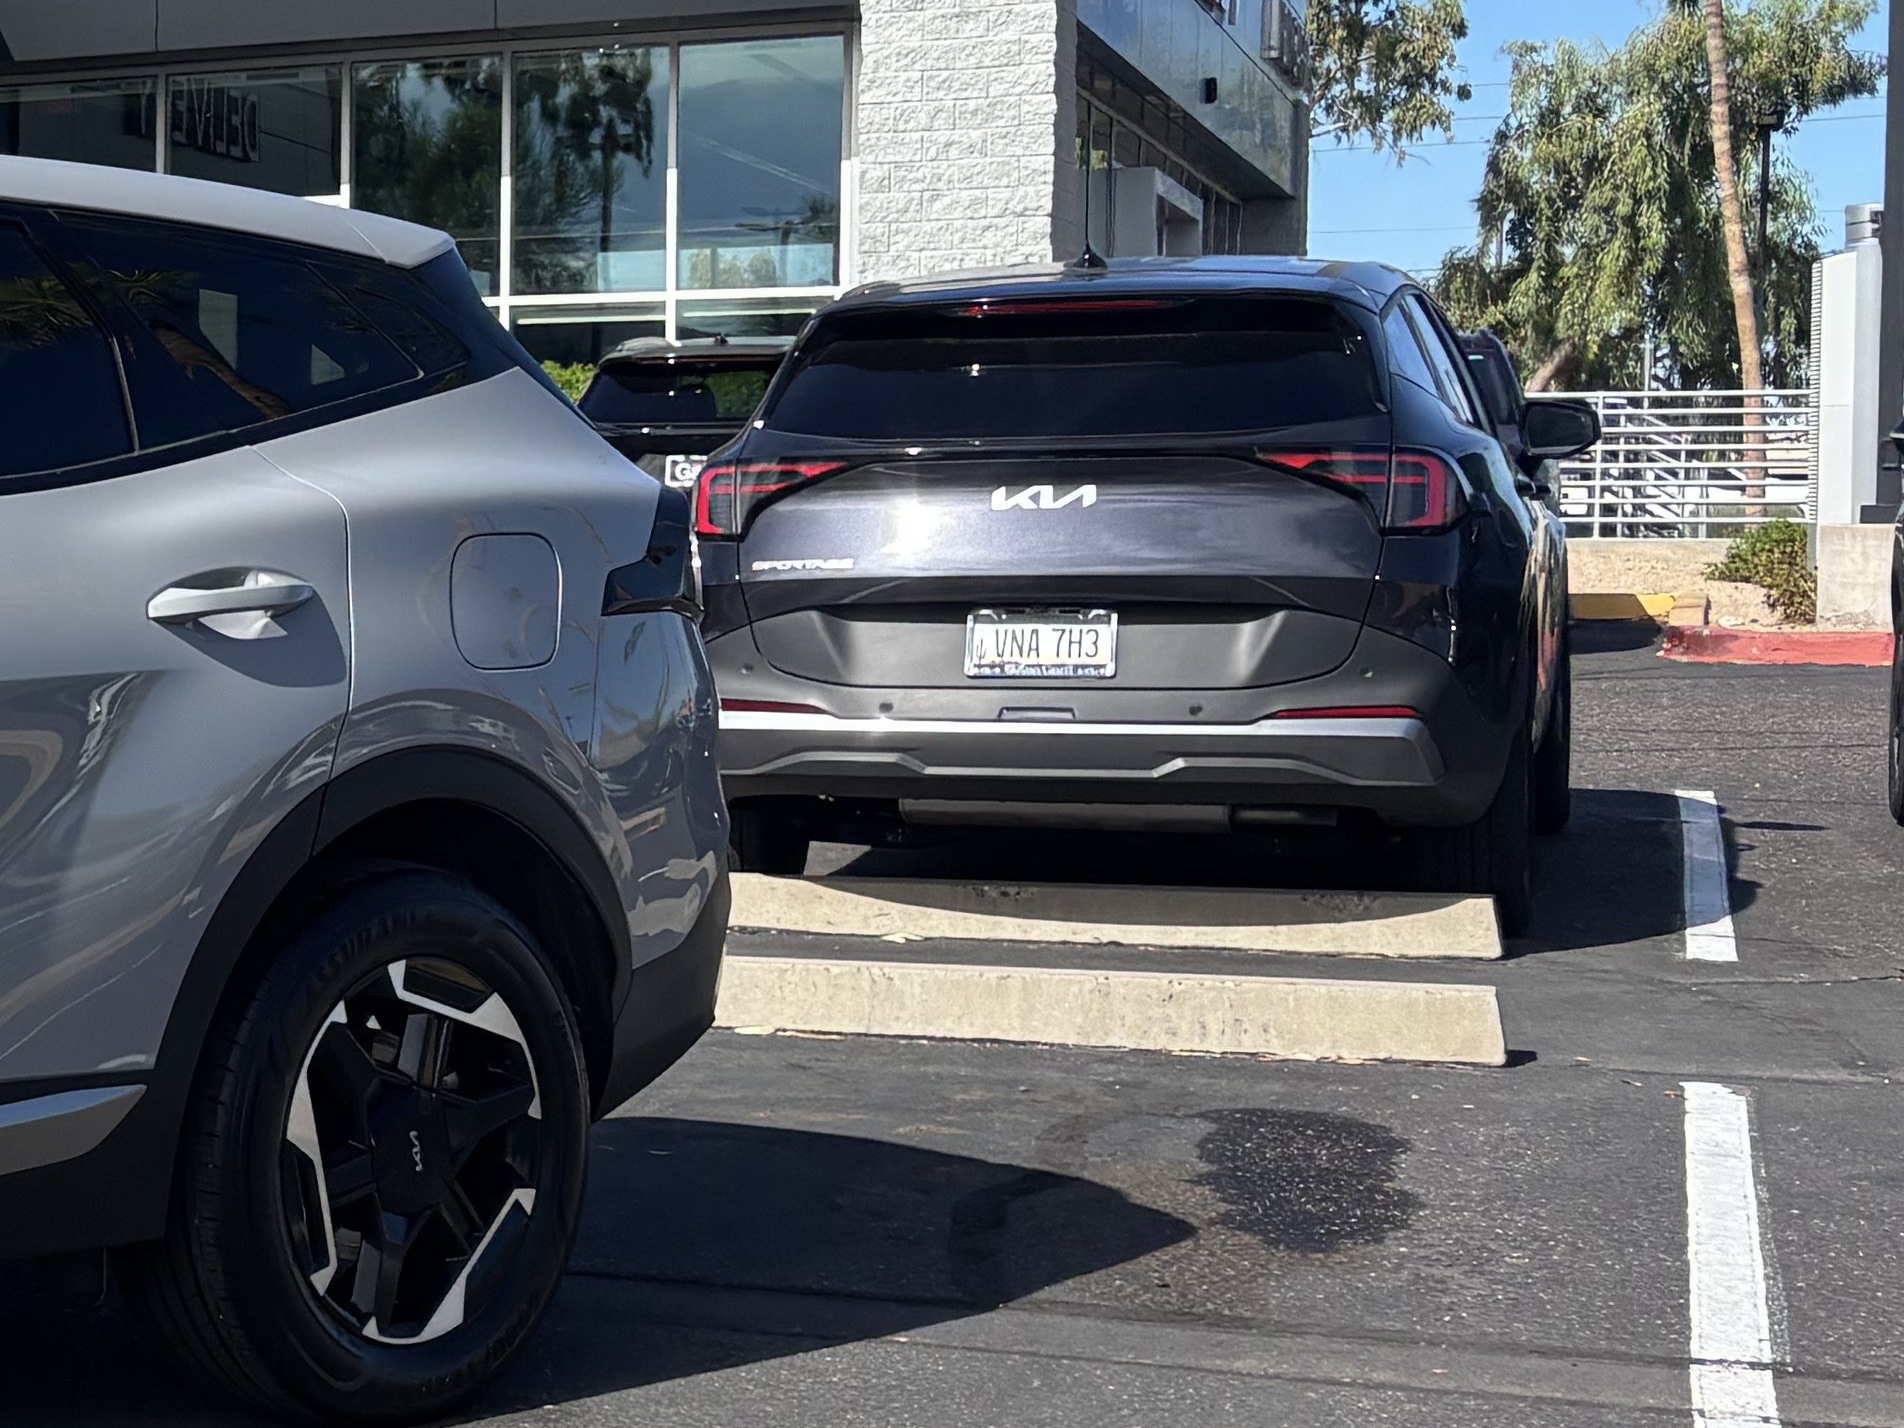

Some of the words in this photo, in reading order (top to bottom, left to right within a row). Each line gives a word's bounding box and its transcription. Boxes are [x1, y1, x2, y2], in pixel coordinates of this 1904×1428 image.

[991, 484, 1097, 510] KIA
[995, 628, 1040, 659] VNA
[1052, 628, 1099, 659] 7H3
